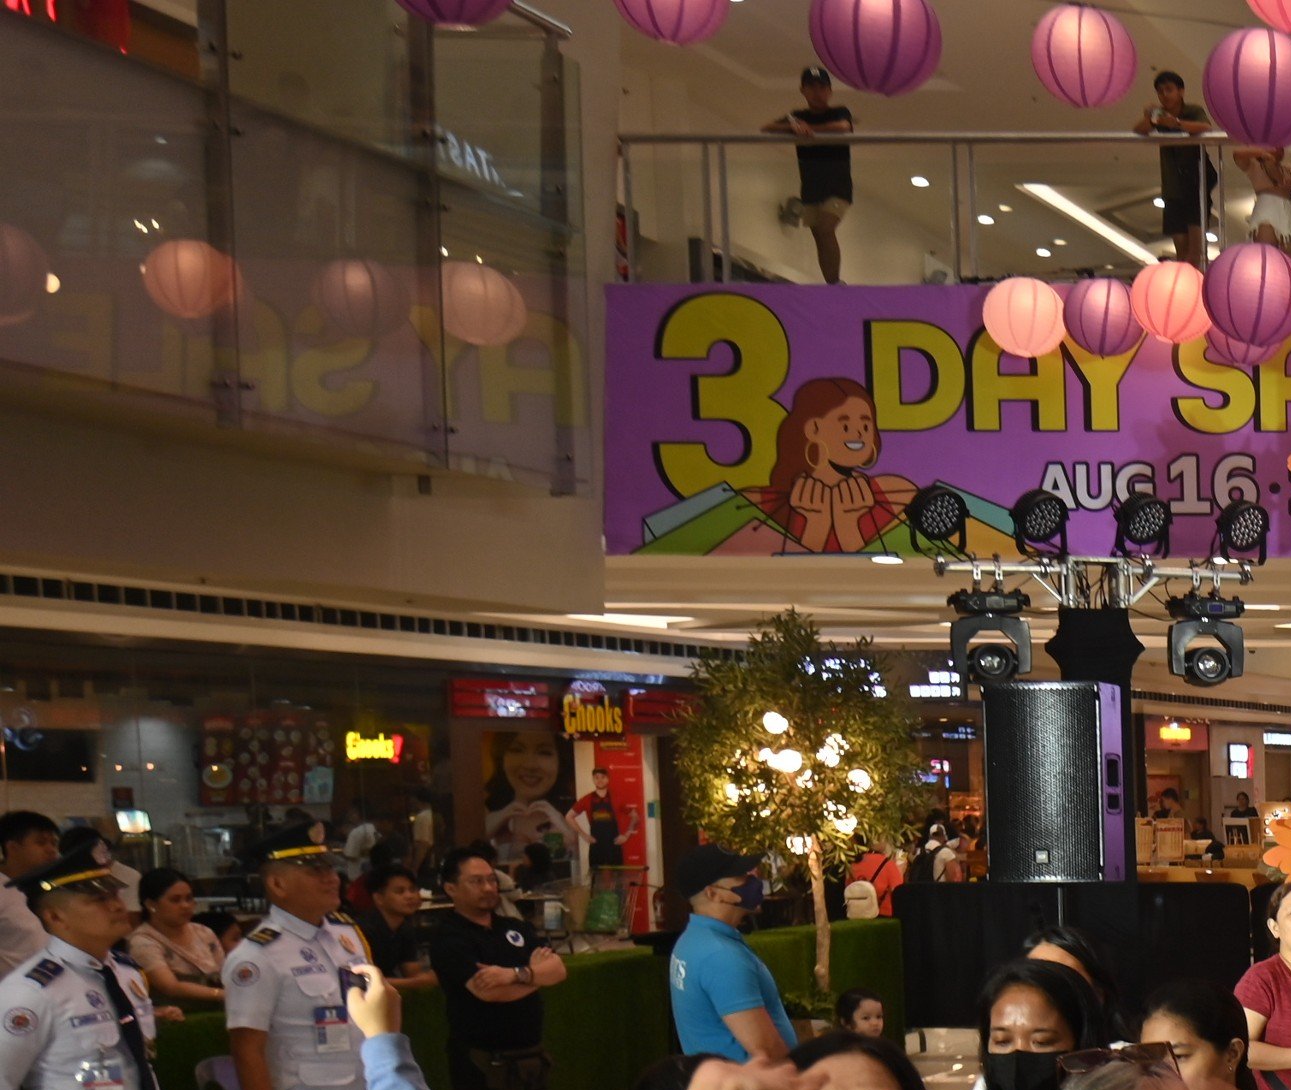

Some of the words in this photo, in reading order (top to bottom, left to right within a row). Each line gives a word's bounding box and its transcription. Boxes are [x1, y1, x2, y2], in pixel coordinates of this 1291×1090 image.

[652, 290, 790, 502] 3
[864, 319, 1148, 432] DAY
[1040, 461, 1155, 514] AUG
[1168, 453, 1258, 516] 16
